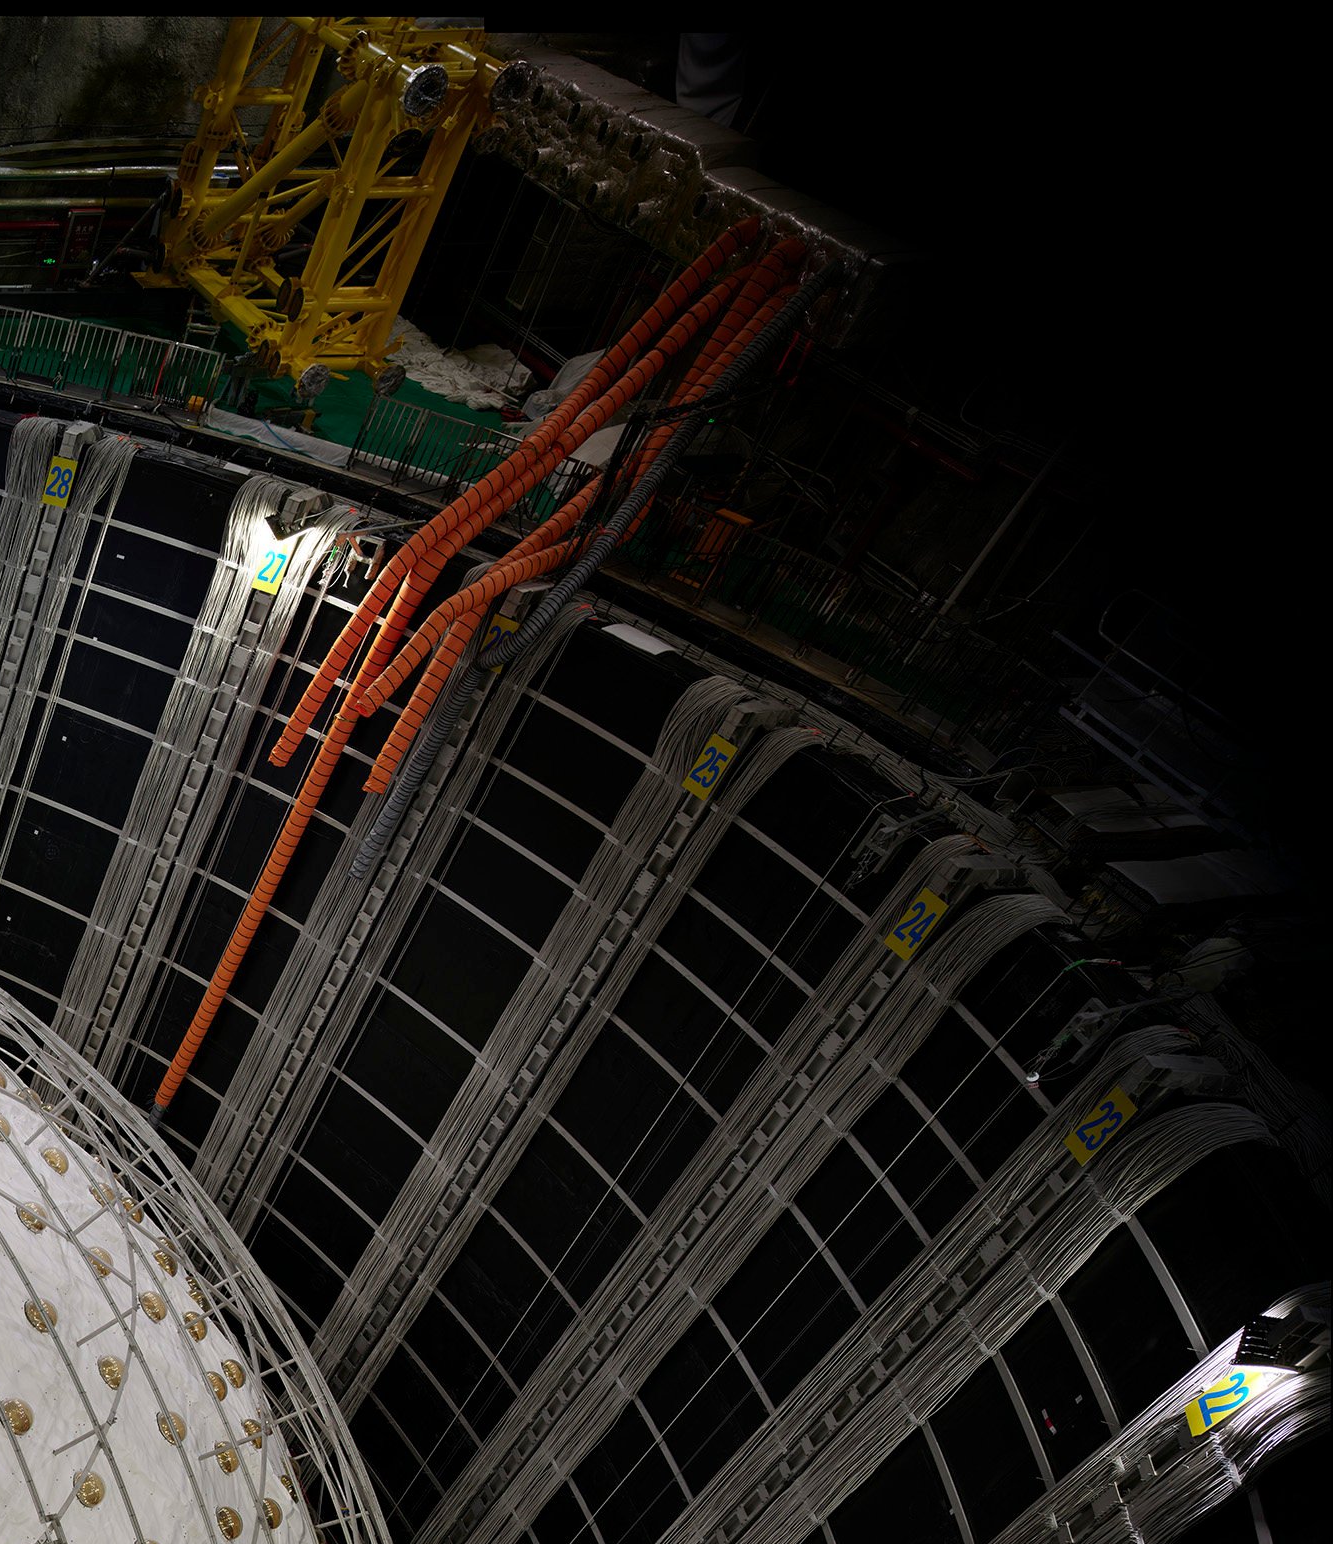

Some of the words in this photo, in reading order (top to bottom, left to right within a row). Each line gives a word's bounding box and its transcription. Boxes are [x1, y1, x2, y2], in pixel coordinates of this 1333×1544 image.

[46, 466, 72, 498] 28
[257, 551, 287, 584] 27
[691, 747, 728, 788] 25
[894, 902, 934, 948] 24
[1076, 1101, 1123, 1150] 23
[1198, 1373, 1248, 1427] 22
